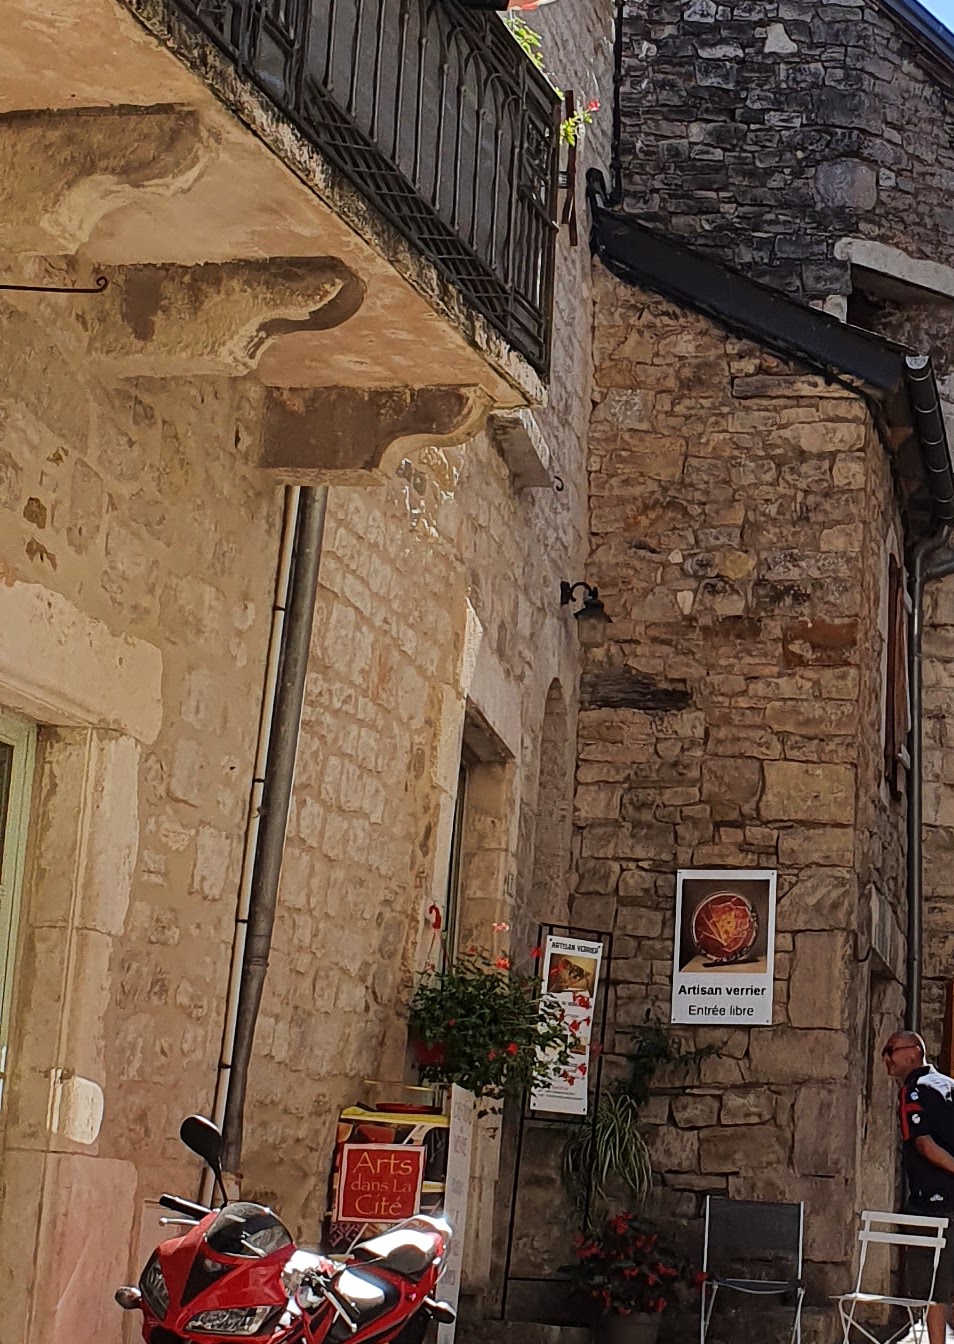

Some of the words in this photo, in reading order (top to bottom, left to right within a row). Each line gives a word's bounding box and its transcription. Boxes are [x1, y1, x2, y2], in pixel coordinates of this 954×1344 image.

[678, 984, 722, 996] Artisan
[726, 985, 766, 996] verrier
[688, 1004, 726, 1016] Entrée
[729, 1005, 754, 1016] libre
[353, 1151, 413, 1175] Arts
[350, 1173, 389, 1191] dans
[392, 1179, 412, 1193] La
[355, 1194, 402, 1216] Cité
